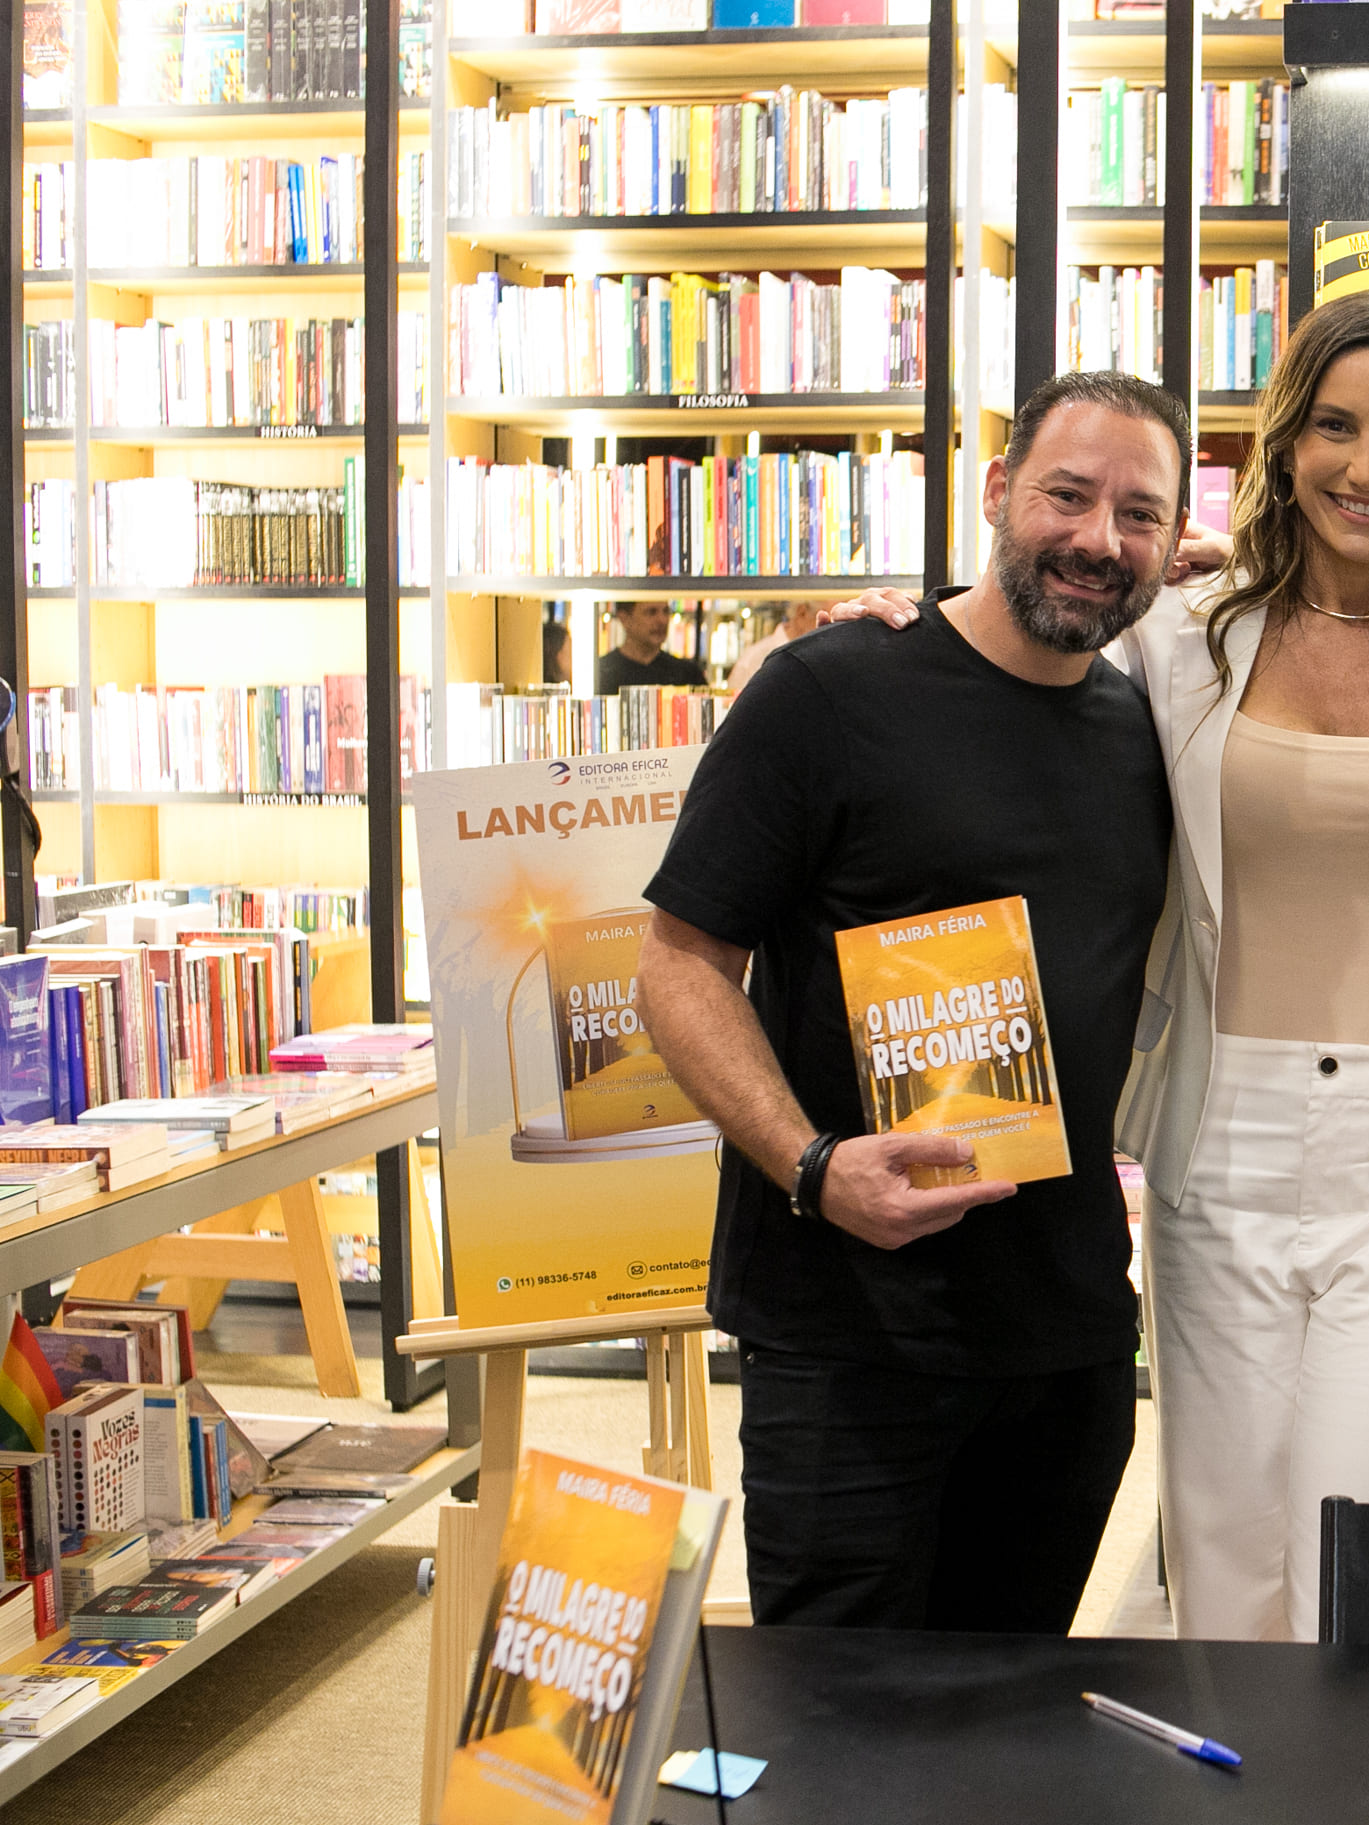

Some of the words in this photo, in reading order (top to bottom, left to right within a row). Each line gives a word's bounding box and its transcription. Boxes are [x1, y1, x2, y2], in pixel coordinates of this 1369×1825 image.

[678, 394, 749, 409] FILOSOFIA
[579, 761, 629, 777] EDITORA
[632, 758, 670, 772] EFICAZ
[580, 771, 673, 785] INTERNACIONAL
[243, 792, 298, 807] HISTÓRIA
[301, 794, 320, 807] DO
[322, 794, 362, 808] BRASIL
[456, 791, 688, 840] LANÇAME
[585, 925, 635, 943] MAIRA
[879, 924, 935, 948] MAIRA
[938, 913, 987, 936] FÉRIA
[569, 984, 584, 1011] O
[587, 977, 638, 1010] MILA
[867, 1003, 883, 1037] O
[885, 980, 1000, 1037] MILAGRE
[1001, 975, 1027, 1010] DO
[571, 1007, 646, 1042] RECO
[871, 1016, 1033, 1080] RECOMEÇO
[944, 1119, 981, 1133] PASSADO
[989, 1112, 1031, 1125] ENCONTRE
[1032, 1110, 1039, 1118] A
[978, 1129, 1001, 1139] QUEM
[515, 1278, 535, 1289] (11)
[537, 1270, 597, 1286] 98336-5748
[606, 1284, 707, 1302] editoraeficaz.com.br
[101, 1410, 135, 1441] Vozes
[93, 1424, 140, 1464] Negras
[556, 1471, 609, 1507] MAIRA
[611, 1482, 652, 1517] FÉRIA
[506, 1559, 529, 1606] O
[522, 1564, 627, 1646] MILAGRE
[620, 1596, 648, 1648] DO
[491, 1615, 633, 1723] RECOMEÇO
